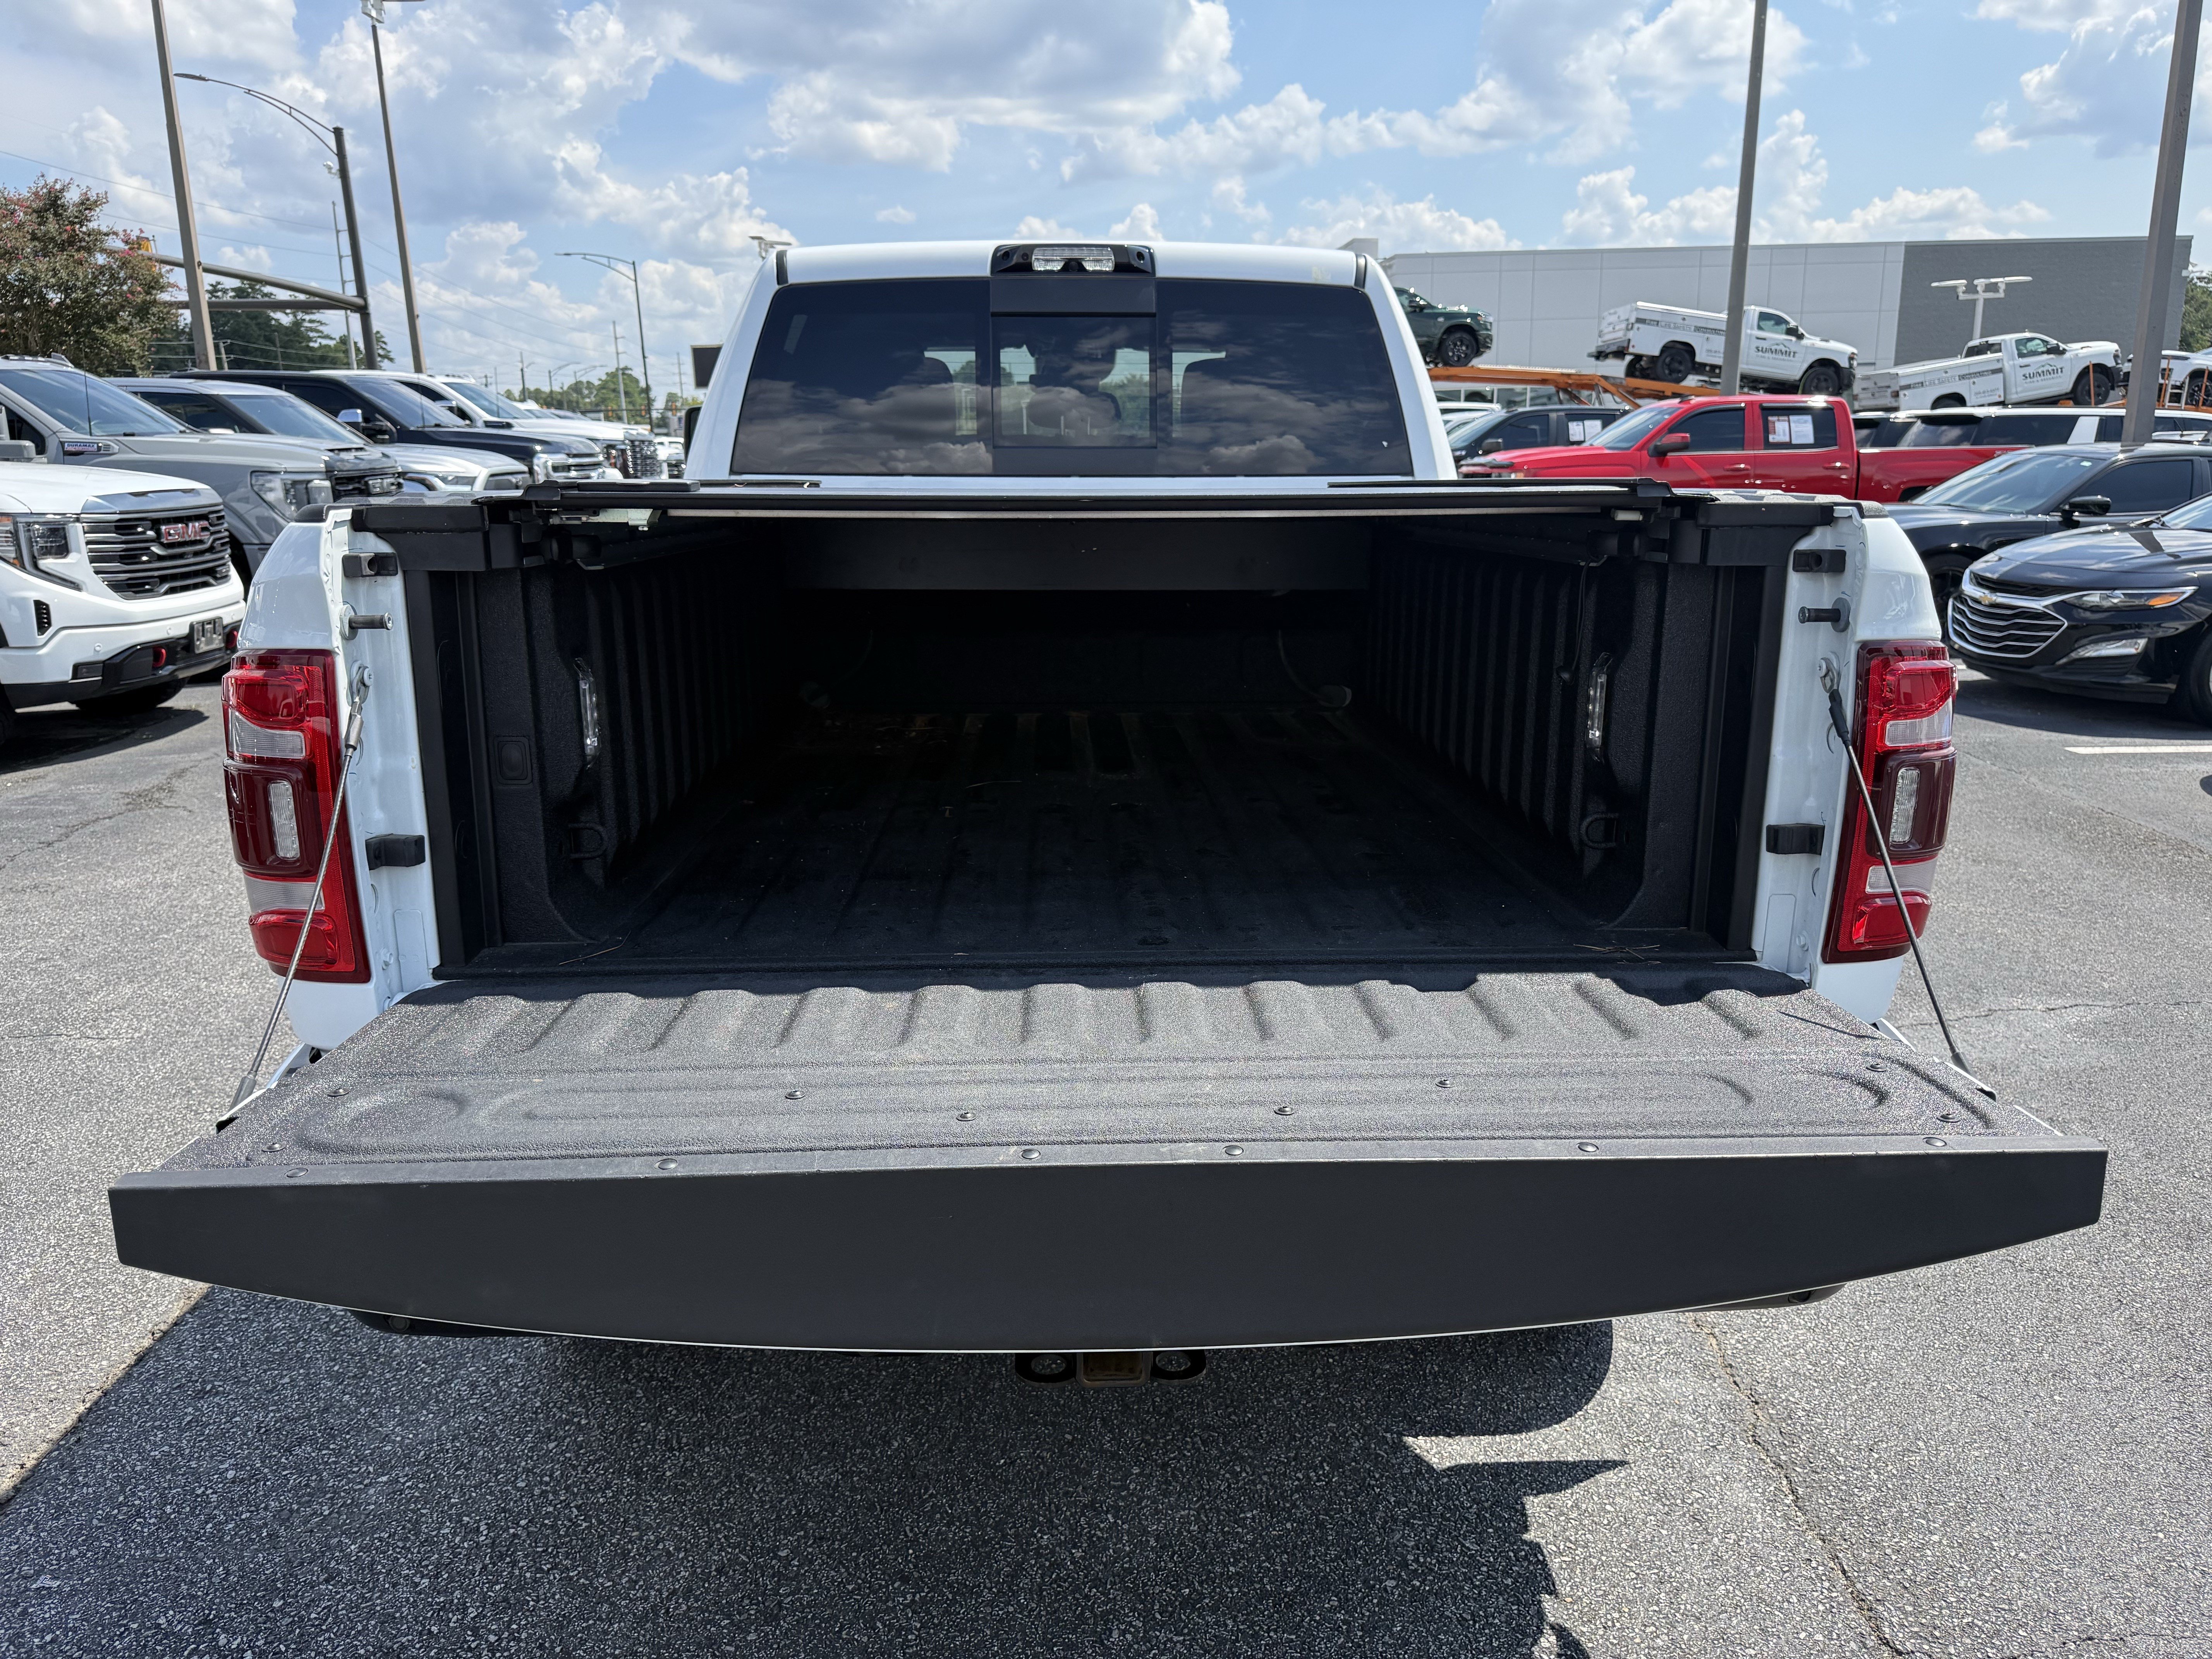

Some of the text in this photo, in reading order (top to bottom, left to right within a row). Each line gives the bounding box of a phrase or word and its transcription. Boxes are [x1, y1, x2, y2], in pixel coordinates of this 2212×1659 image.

[1755, 345, 1798, 358] SUMMIT
[2022, 366, 2065, 380] SUMMIT
[160, 521, 210, 543] GMC
